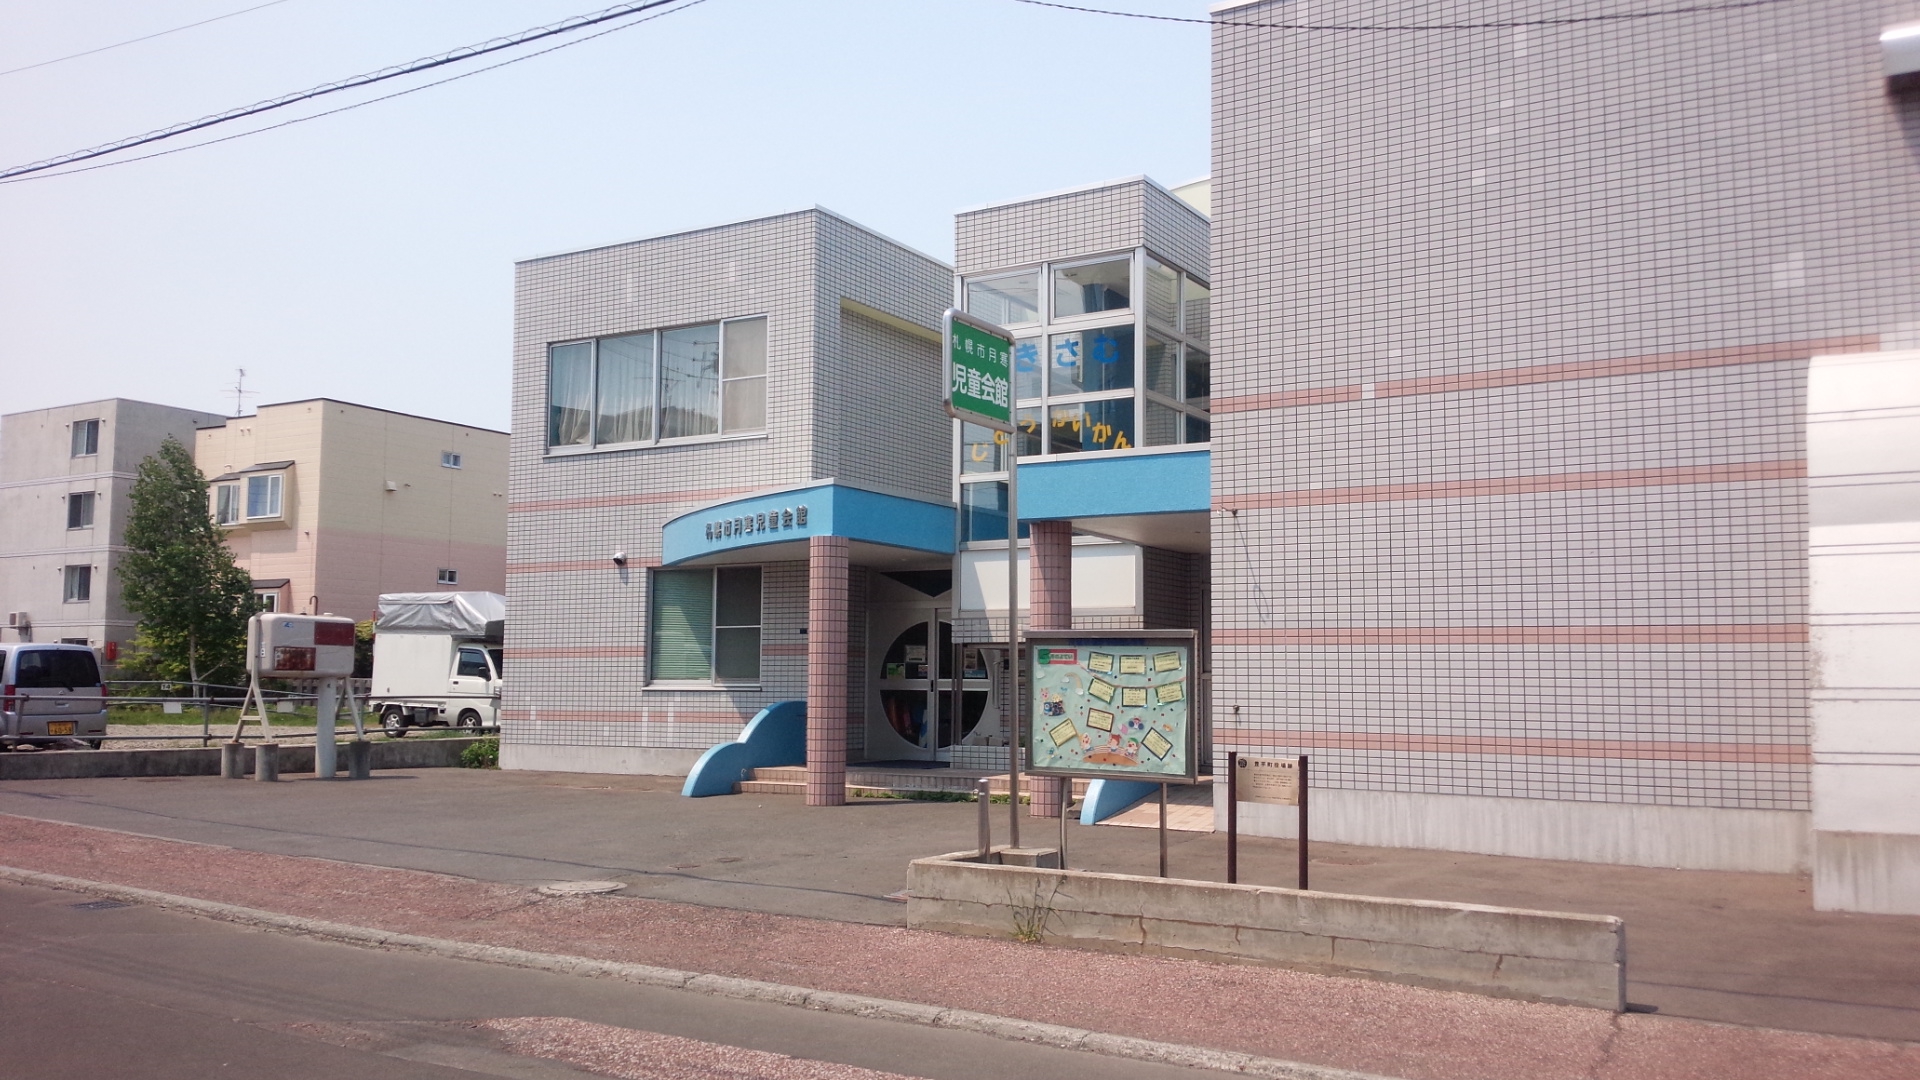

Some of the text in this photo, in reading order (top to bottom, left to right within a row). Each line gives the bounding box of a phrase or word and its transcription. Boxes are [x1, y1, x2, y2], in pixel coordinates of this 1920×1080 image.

[952, 334, 1008, 368] 札幌市月寒
[1016, 334, 1119, 372] きさむ
[952, 361, 1008, 408] 児童会館
[705, 505, 808, 540] 札幌市月寒児童会館
